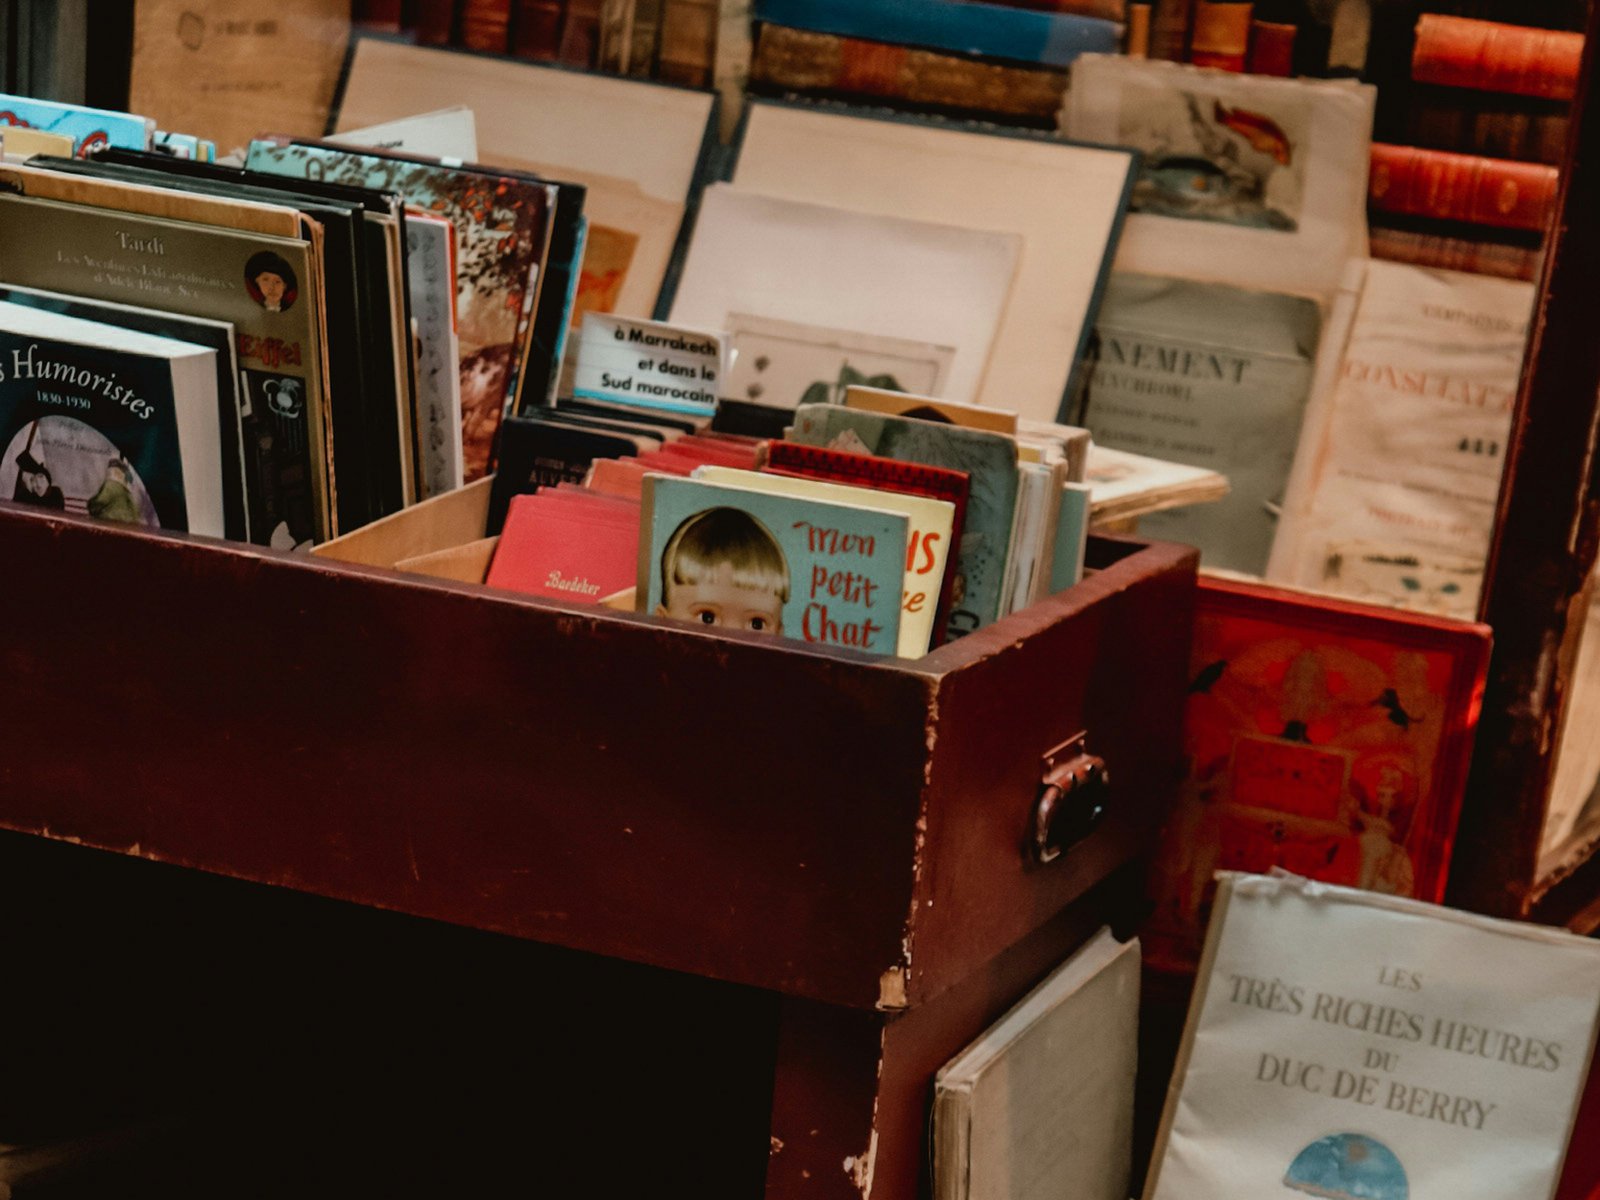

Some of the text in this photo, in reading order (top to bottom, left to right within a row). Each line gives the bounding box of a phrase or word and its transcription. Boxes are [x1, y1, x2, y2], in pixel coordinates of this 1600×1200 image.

[115, 231, 164, 254] Tardi
[614, 325, 717, 356] à Marrakech
[638, 359, 716, 381] et dans le
[1108, 338, 1251, 384] NEMENT
[12, 344, 154, 419] Humoristes
[601, 373, 714, 403] Sud marocain
[544, 570, 600, 595] Baedeker
[1377, 965, 1423, 993] LES
[1229, 974, 1563, 1072] TRÈS RICHES HEURES
[1363, 1049, 1400, 1073] DU
[1256, 1053, 1497, 1132] DUC DE BERRY
